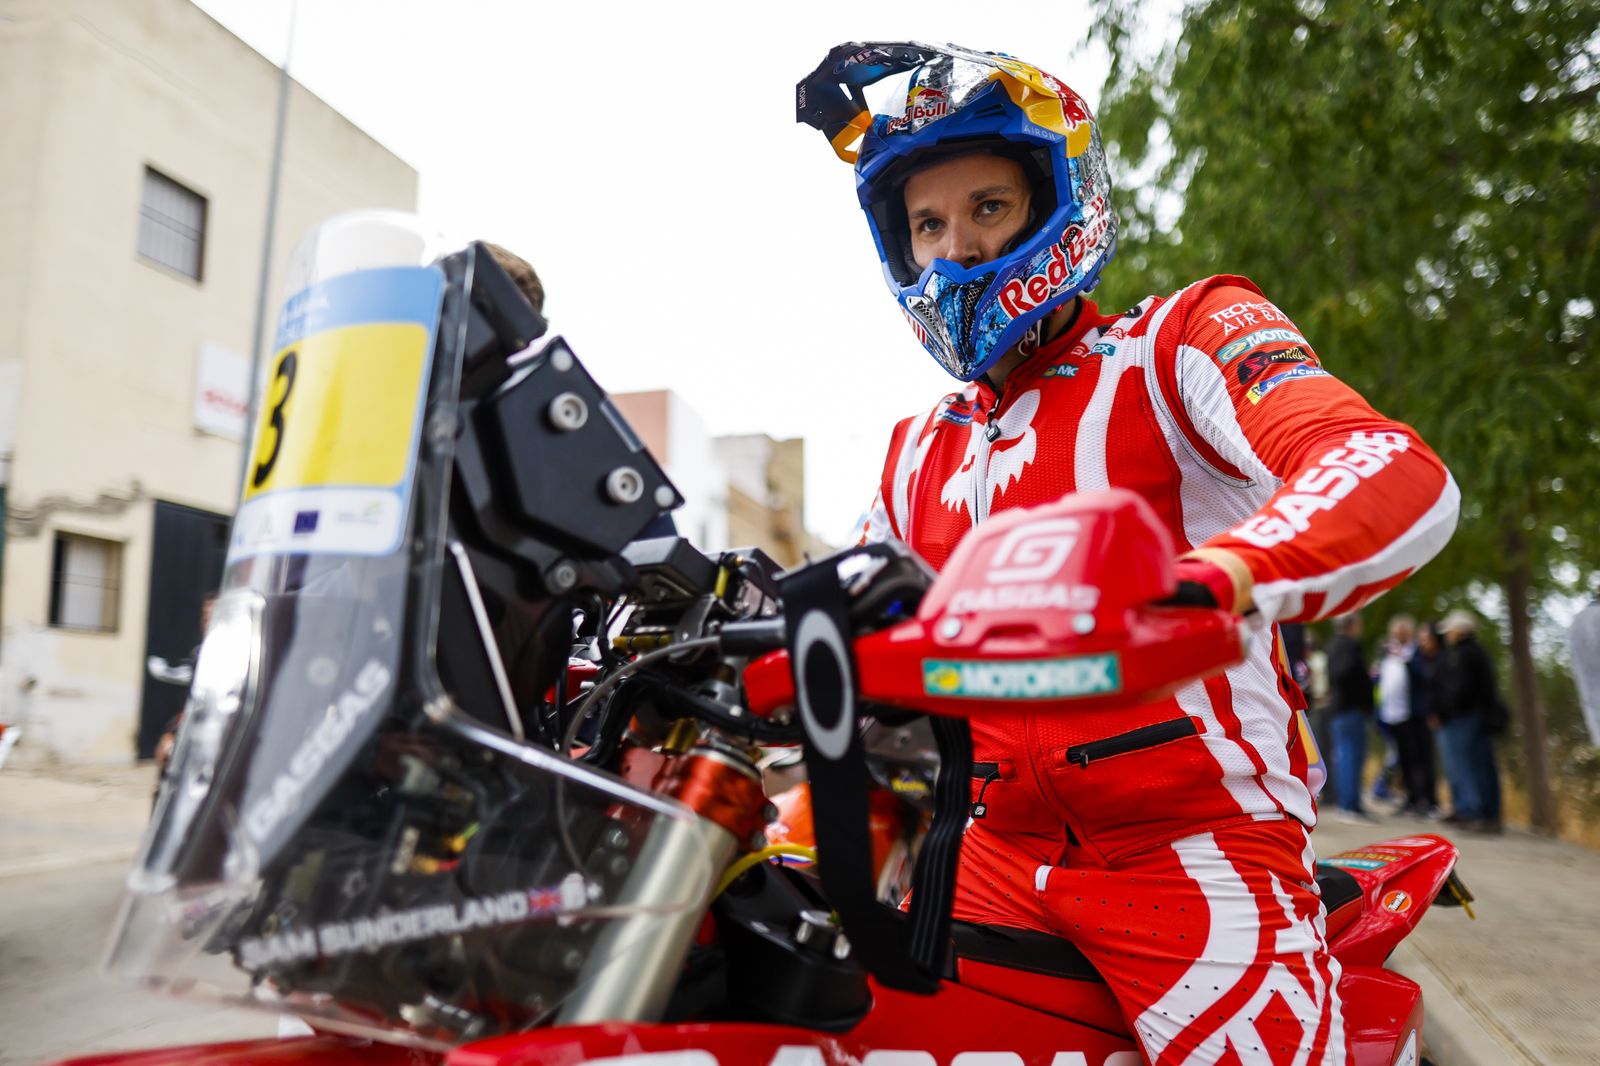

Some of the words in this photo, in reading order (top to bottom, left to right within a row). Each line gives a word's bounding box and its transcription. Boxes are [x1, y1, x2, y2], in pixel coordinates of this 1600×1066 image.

[887, 107, 912, 134] Red
[912, 101, 948, 120] Bull
[998, 243, 1070, 320] Red
[1061, 195, 1108, 270] Bull
[1222, 313, 1260, 337] AIR
[252, 349, 298, 489] 3
[947, 583, 1101, 614] GASGAS
[962, 654, 1114, 696] MOTOREX
[241, 658, 392, 844] GASGAS
[238, 932, 318, 971] SAM
[319, 890, 529, 955] SUNDERLAND
